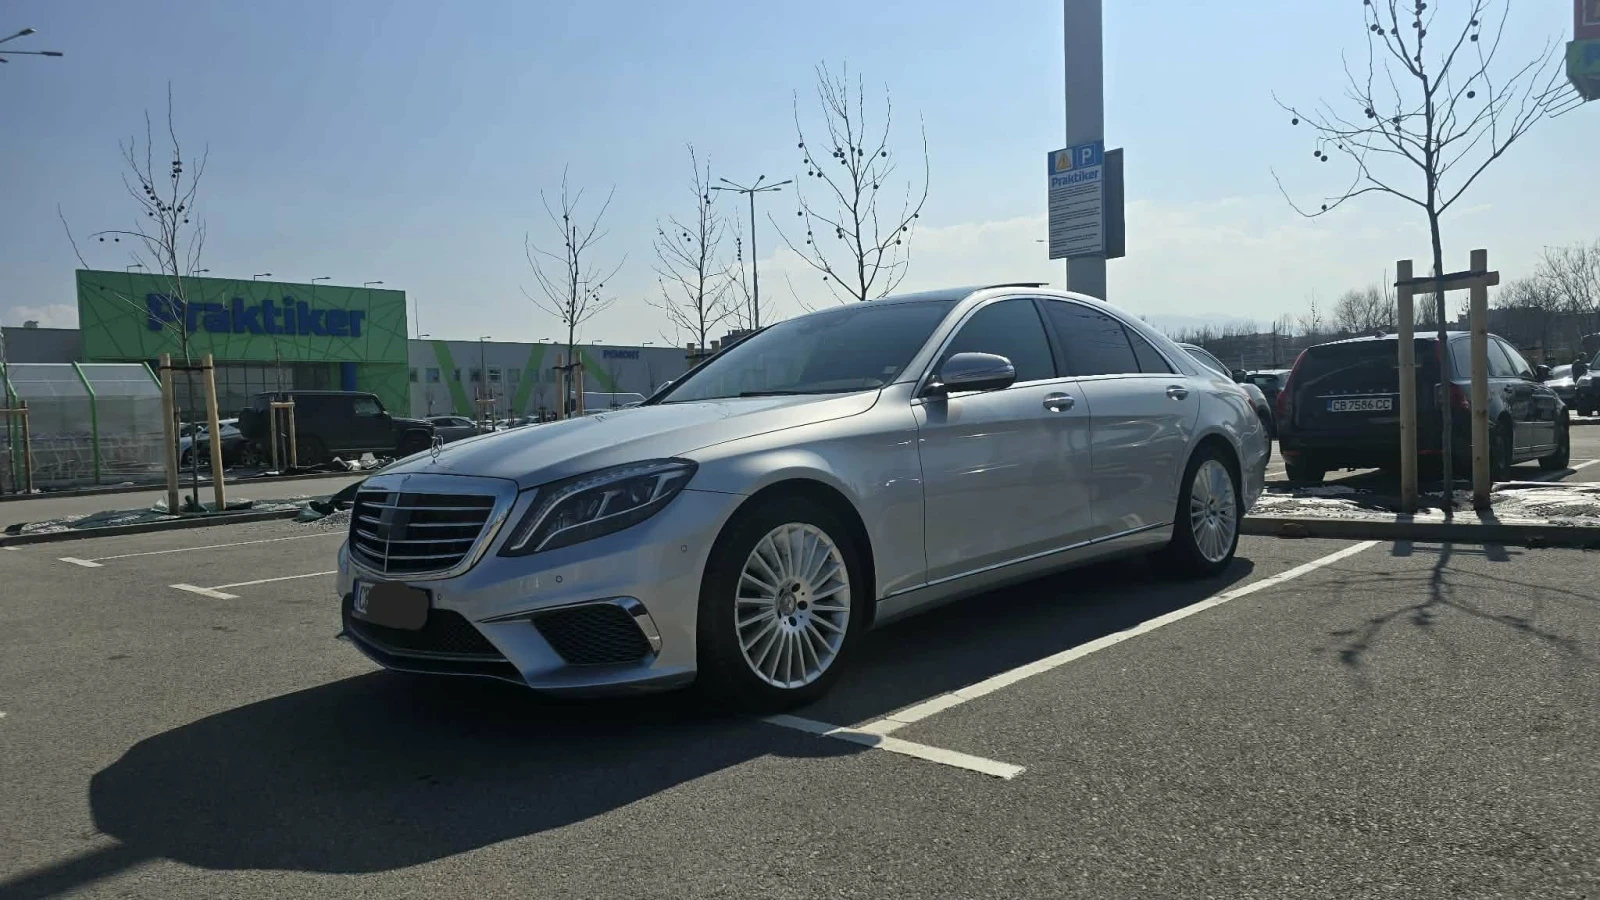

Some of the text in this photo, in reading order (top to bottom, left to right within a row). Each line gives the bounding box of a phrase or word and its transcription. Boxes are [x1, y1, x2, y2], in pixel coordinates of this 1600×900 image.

[1082, 148, 1092, 164] P
[1051, 169, 1099, 188] Praktiker
[147, 293, 365, 338] Praktiker
